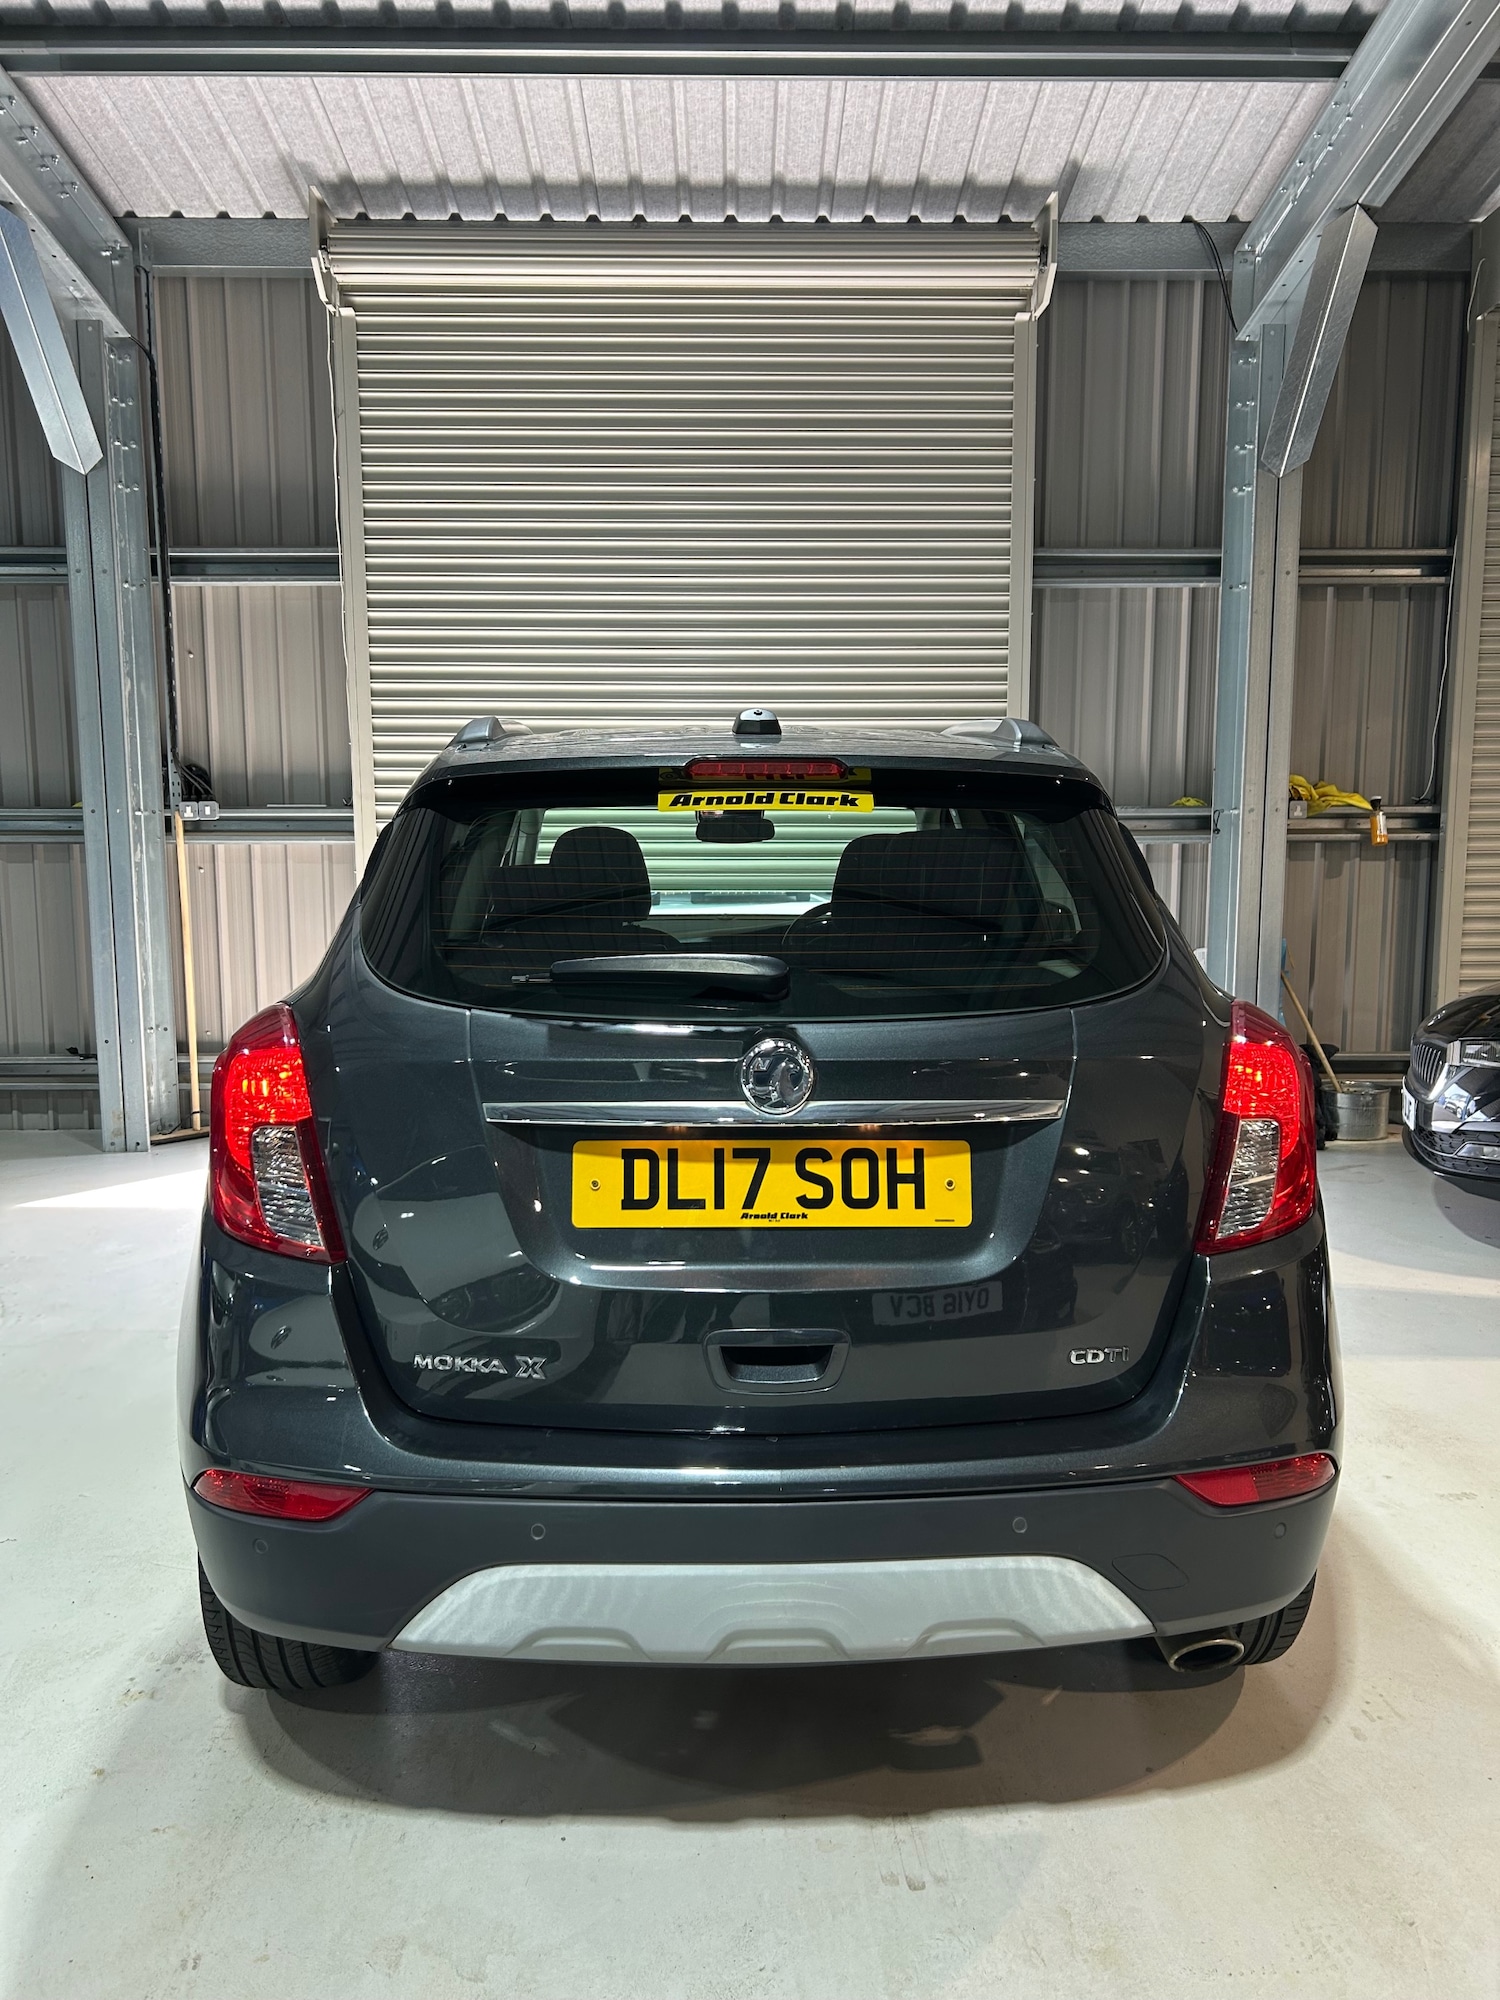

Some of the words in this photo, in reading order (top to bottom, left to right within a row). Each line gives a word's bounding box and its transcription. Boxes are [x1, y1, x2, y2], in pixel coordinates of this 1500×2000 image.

[668, 792, 775, 807] Arnold
[779, 792, 860, 807] Clark
[620, 1147, 772, 1211] DL17
[794, 1147, 926, 1211] SOH
[413, 1353, 508, 1375] MOKKA
[514, 1354, 548, 1380] X
